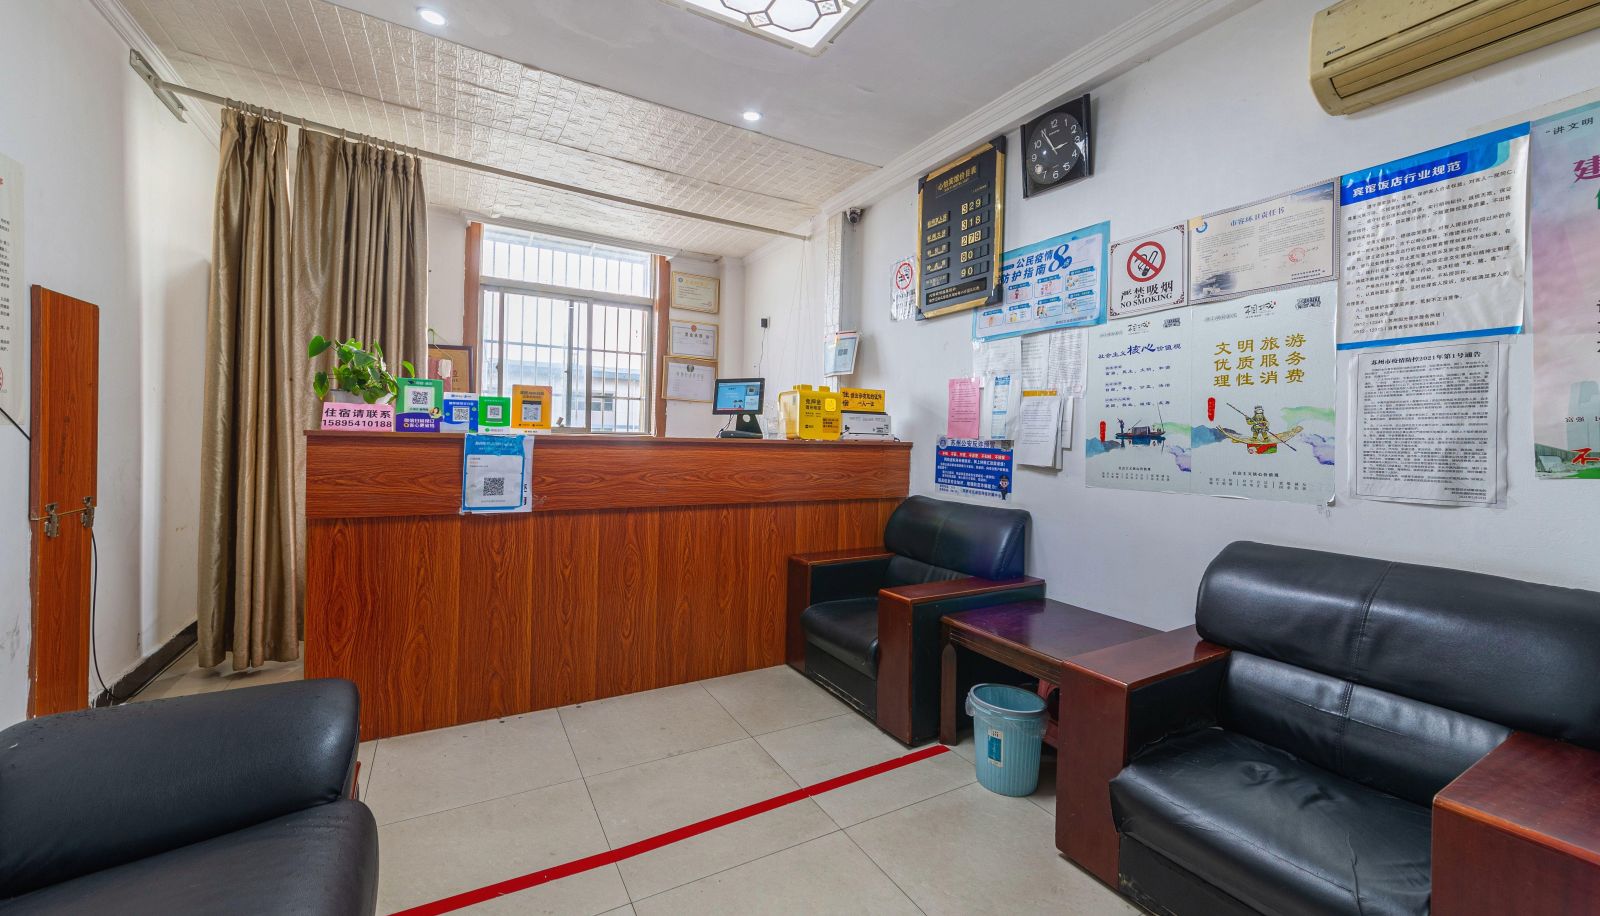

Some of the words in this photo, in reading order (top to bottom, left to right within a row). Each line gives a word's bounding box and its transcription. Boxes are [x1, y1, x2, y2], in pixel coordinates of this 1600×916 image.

[1051, 119, 1058, 128] 12
[1071, 124, 1077, 134] 2
[1034, 140, 1042, 149] 10
[1075, 135, 1081, 143] 3
[1032, 153, 1037, 162] 9
[1072, 149, 1077, 158] 4
[1063, 162, 1070, 171] 5
[1043, 170, 1047, 179] 7
[1052, 170, 1058, 179] 6
[1353, 160, 1461, 198] 宾馆饭店行业规范
[962, 231, 981, 246] 279
[1016, 249, 1054, 268] 公民疫情
[961, 266, 973, 277] 90
[1002, 263, 1047, 284] 防护指南
[1121, 280, 1173, 301] 严禁吸烟
[1121, 299, 1132, 308] NO
[1133, 291, 1173, 306] SMOKING
[1214, 333, 1306, 356] 文明旅游
[1098, 343, 1182, 359] 社会主义核心价值观
[1214, 351, 1306, 371] 优质服务
[1371, 351, 1481, 366] 苏州市疫情防控2021年第1号通告
[1214, 368, 1305, 387] 理性消费
[324, 407, 392, 419] 住宿请联系
[322, 419, 392, 429] 15895410188
